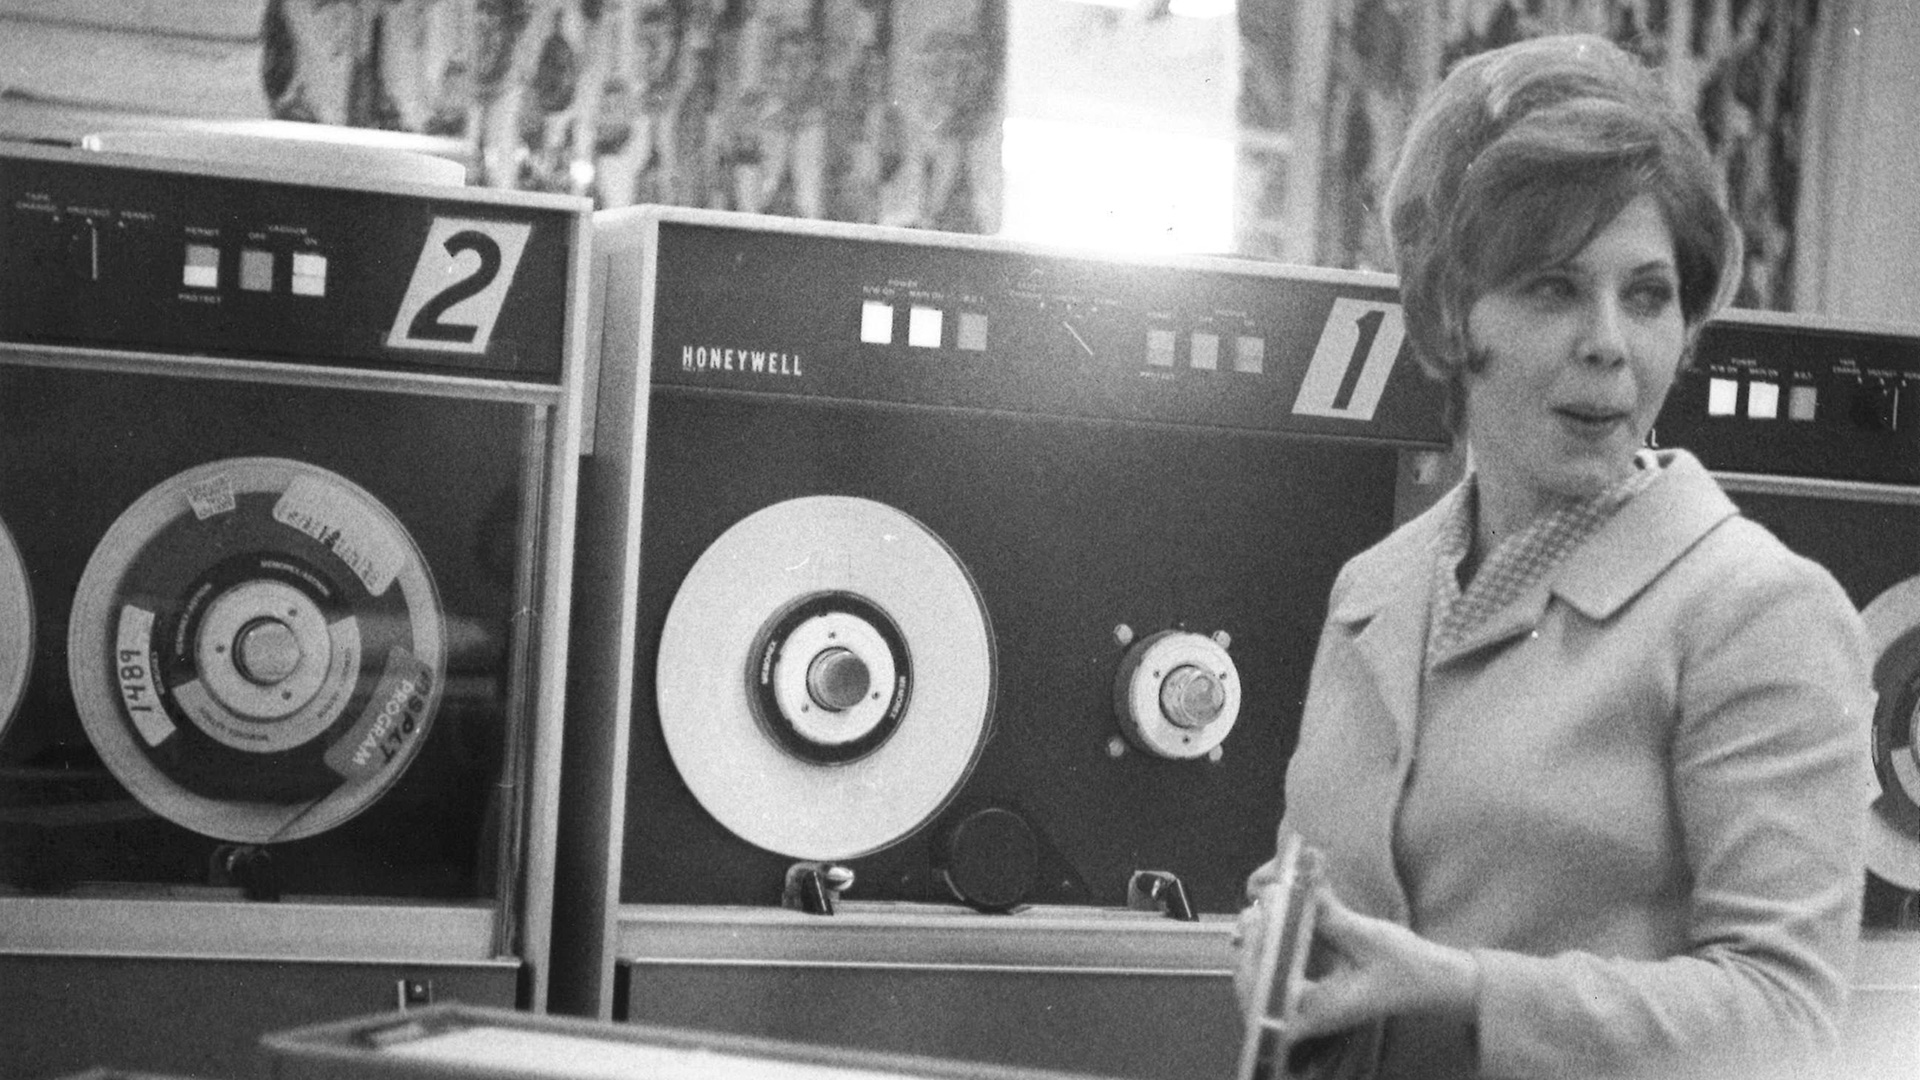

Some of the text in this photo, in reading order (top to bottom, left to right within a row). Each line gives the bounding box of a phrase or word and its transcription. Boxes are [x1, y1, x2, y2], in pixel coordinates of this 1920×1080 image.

[407, 231, 501, 343] 2
[682, 345, 802, 376] HONEYWELL
[1332, 310, 1387, 410] 1
[120, 649, 152, 713] 1489
[351, 678, 414, 768] PROGRAM
